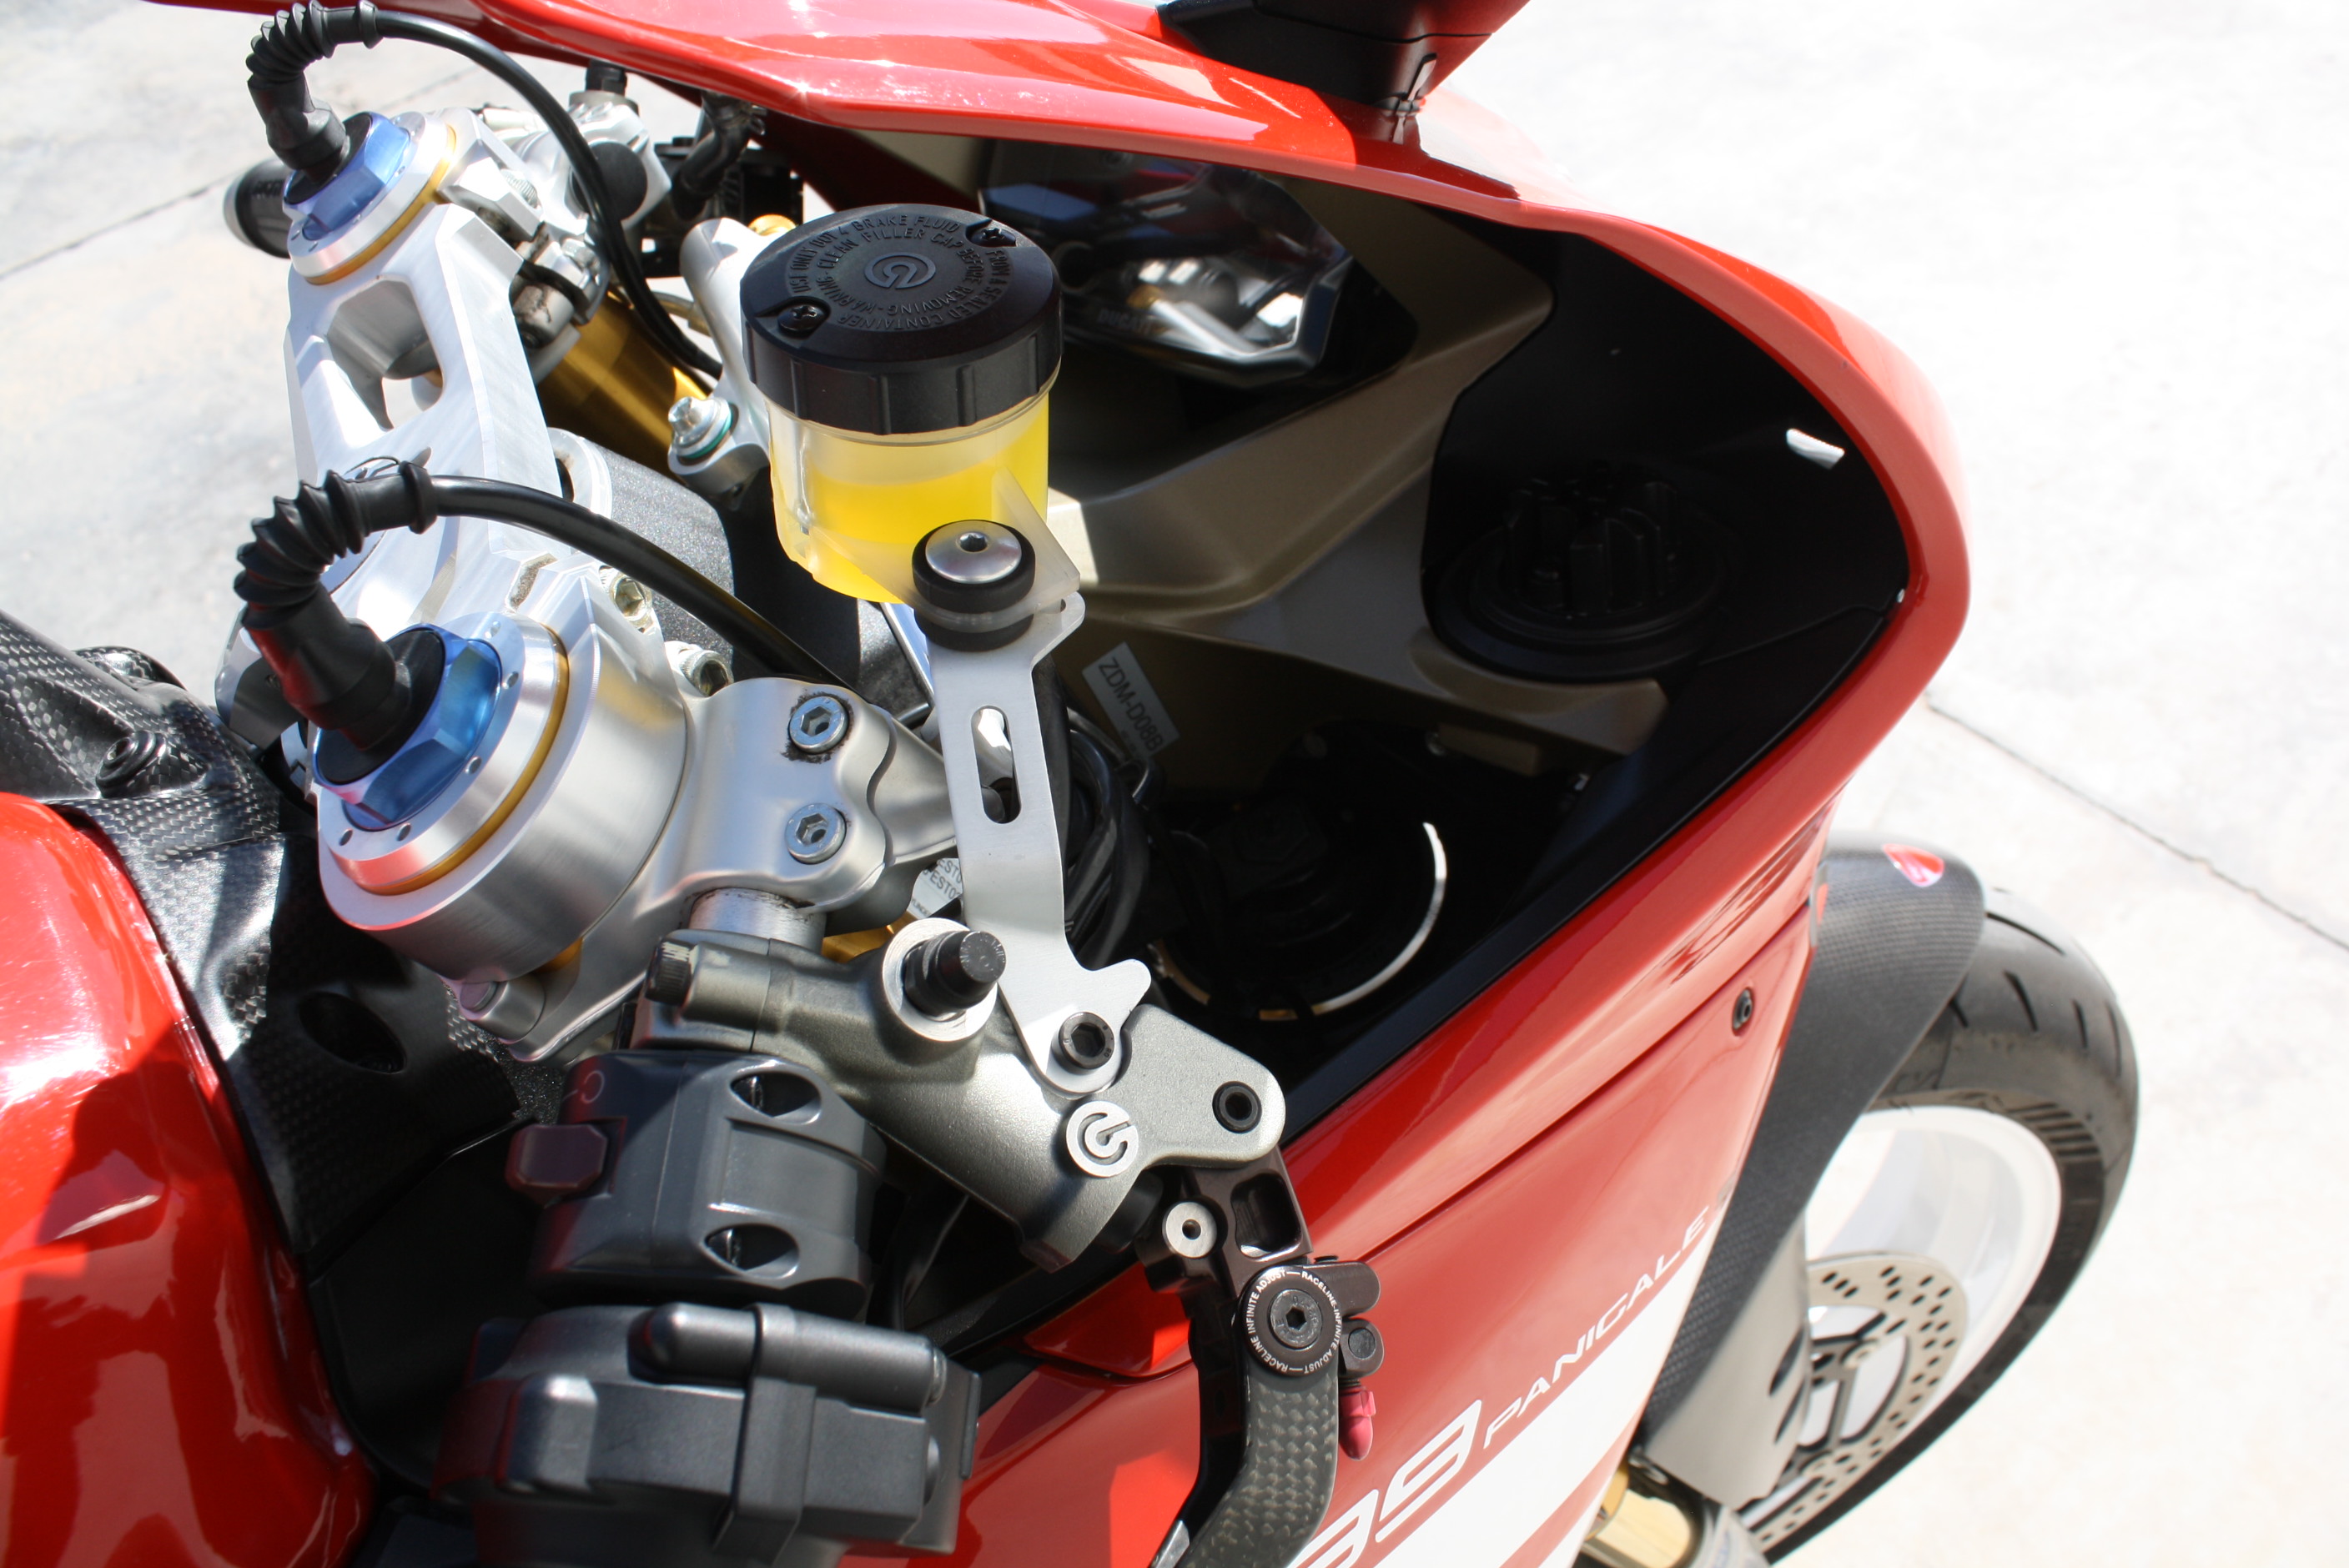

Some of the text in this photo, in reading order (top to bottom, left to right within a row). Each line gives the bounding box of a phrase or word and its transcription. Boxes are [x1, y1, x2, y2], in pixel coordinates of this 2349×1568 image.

[838, 226, 849, 235] 4
[851, 215, 908, 231] BRAKE
[914, 216, 960, 233] FLUID
[809, 231, 838, 248] DOT
[790, 246, 817, 270] ONLY
[985, 250, 1010, 276] FROM
[816, 228, 984, 315] WARNING CLEAN FILLER CAP BEFORE REMOVING
[948, 286, 1002, 319] SEALED
[837, 313, 943, 330] CONTAINER
[1098, 656, 1164, 751] ZDM-D08B
[1246, 1269, 1289, 1373] RACELINE INFINITE ADJUST
[1483, 1205, 1710, 1450] PANIGALE
[1303, 1349, 1333, 1374] ADJUST
